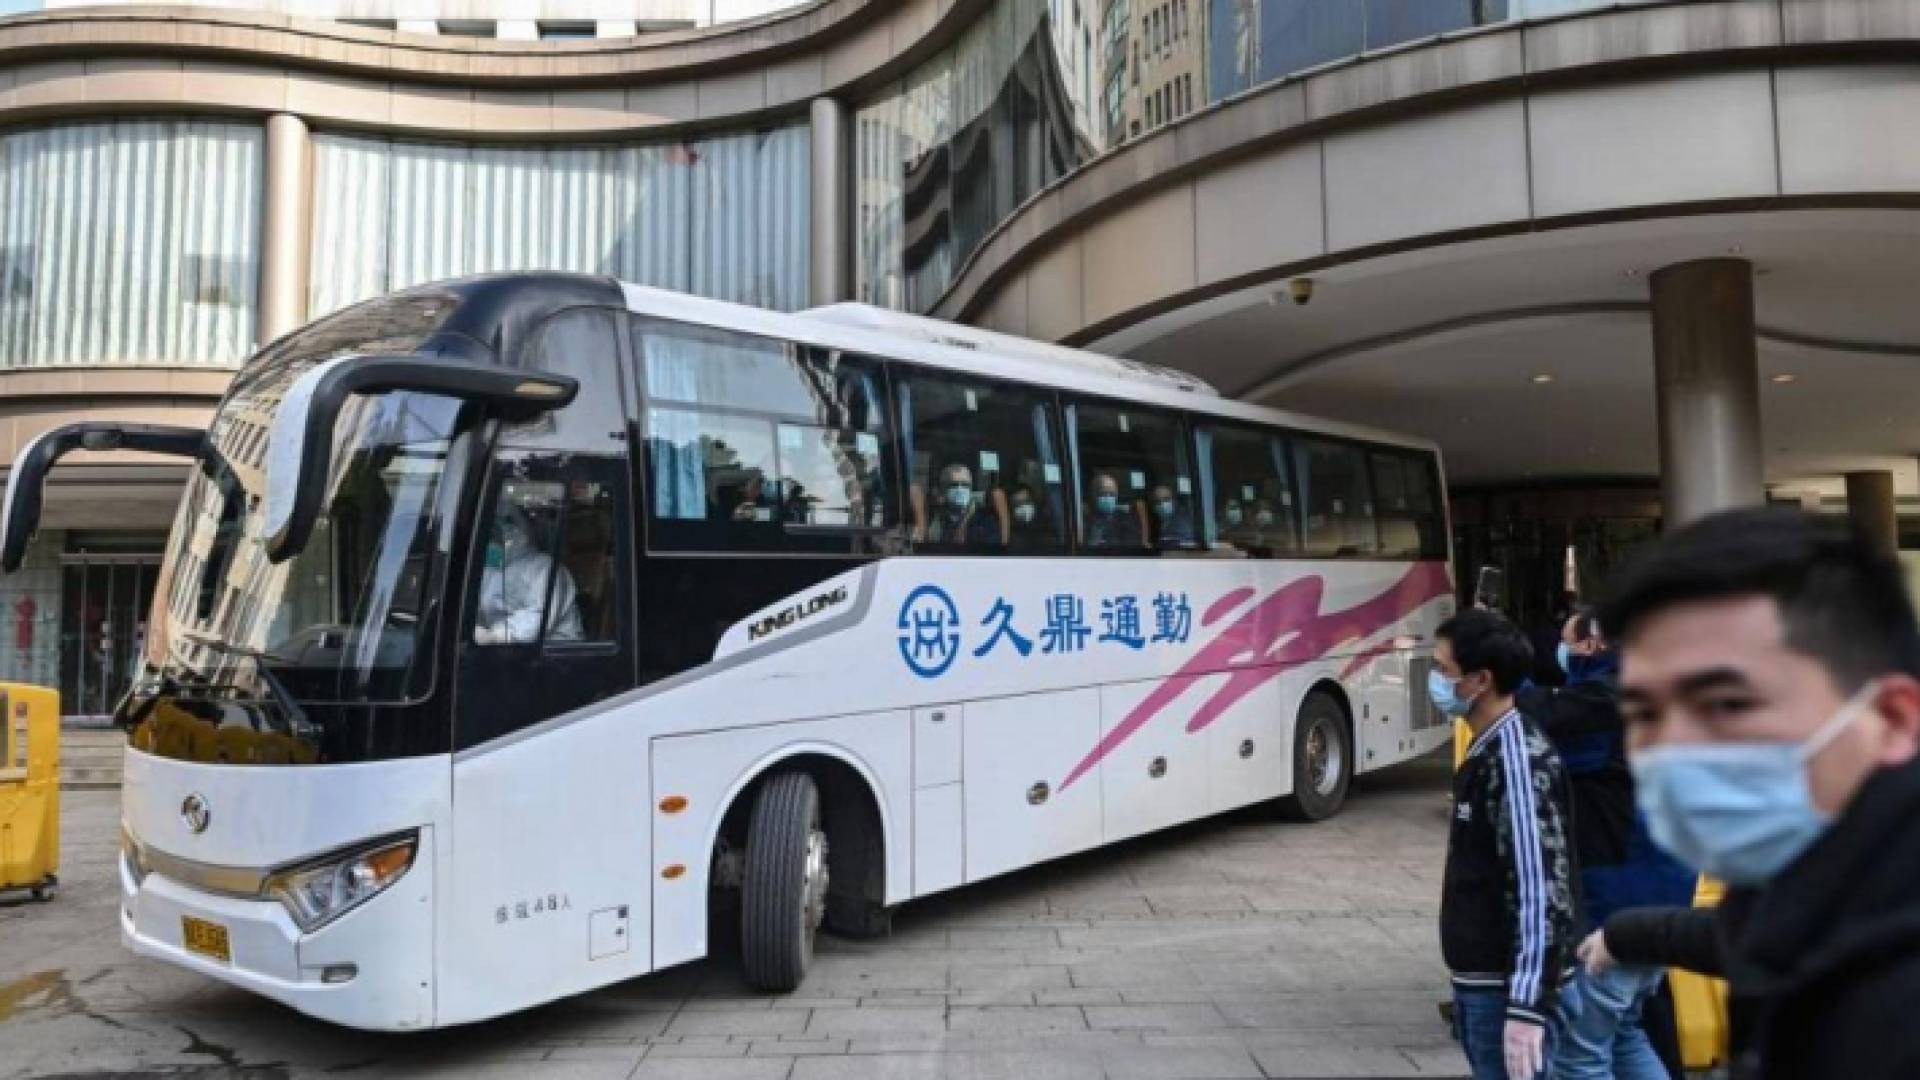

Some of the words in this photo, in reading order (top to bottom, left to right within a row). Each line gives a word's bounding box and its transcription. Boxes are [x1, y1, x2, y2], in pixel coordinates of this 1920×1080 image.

[748, 606, 795, 641] KING
[796, 585, 849, 620] LONG
[972, 591, 1193, 657] 久鼎通勤
